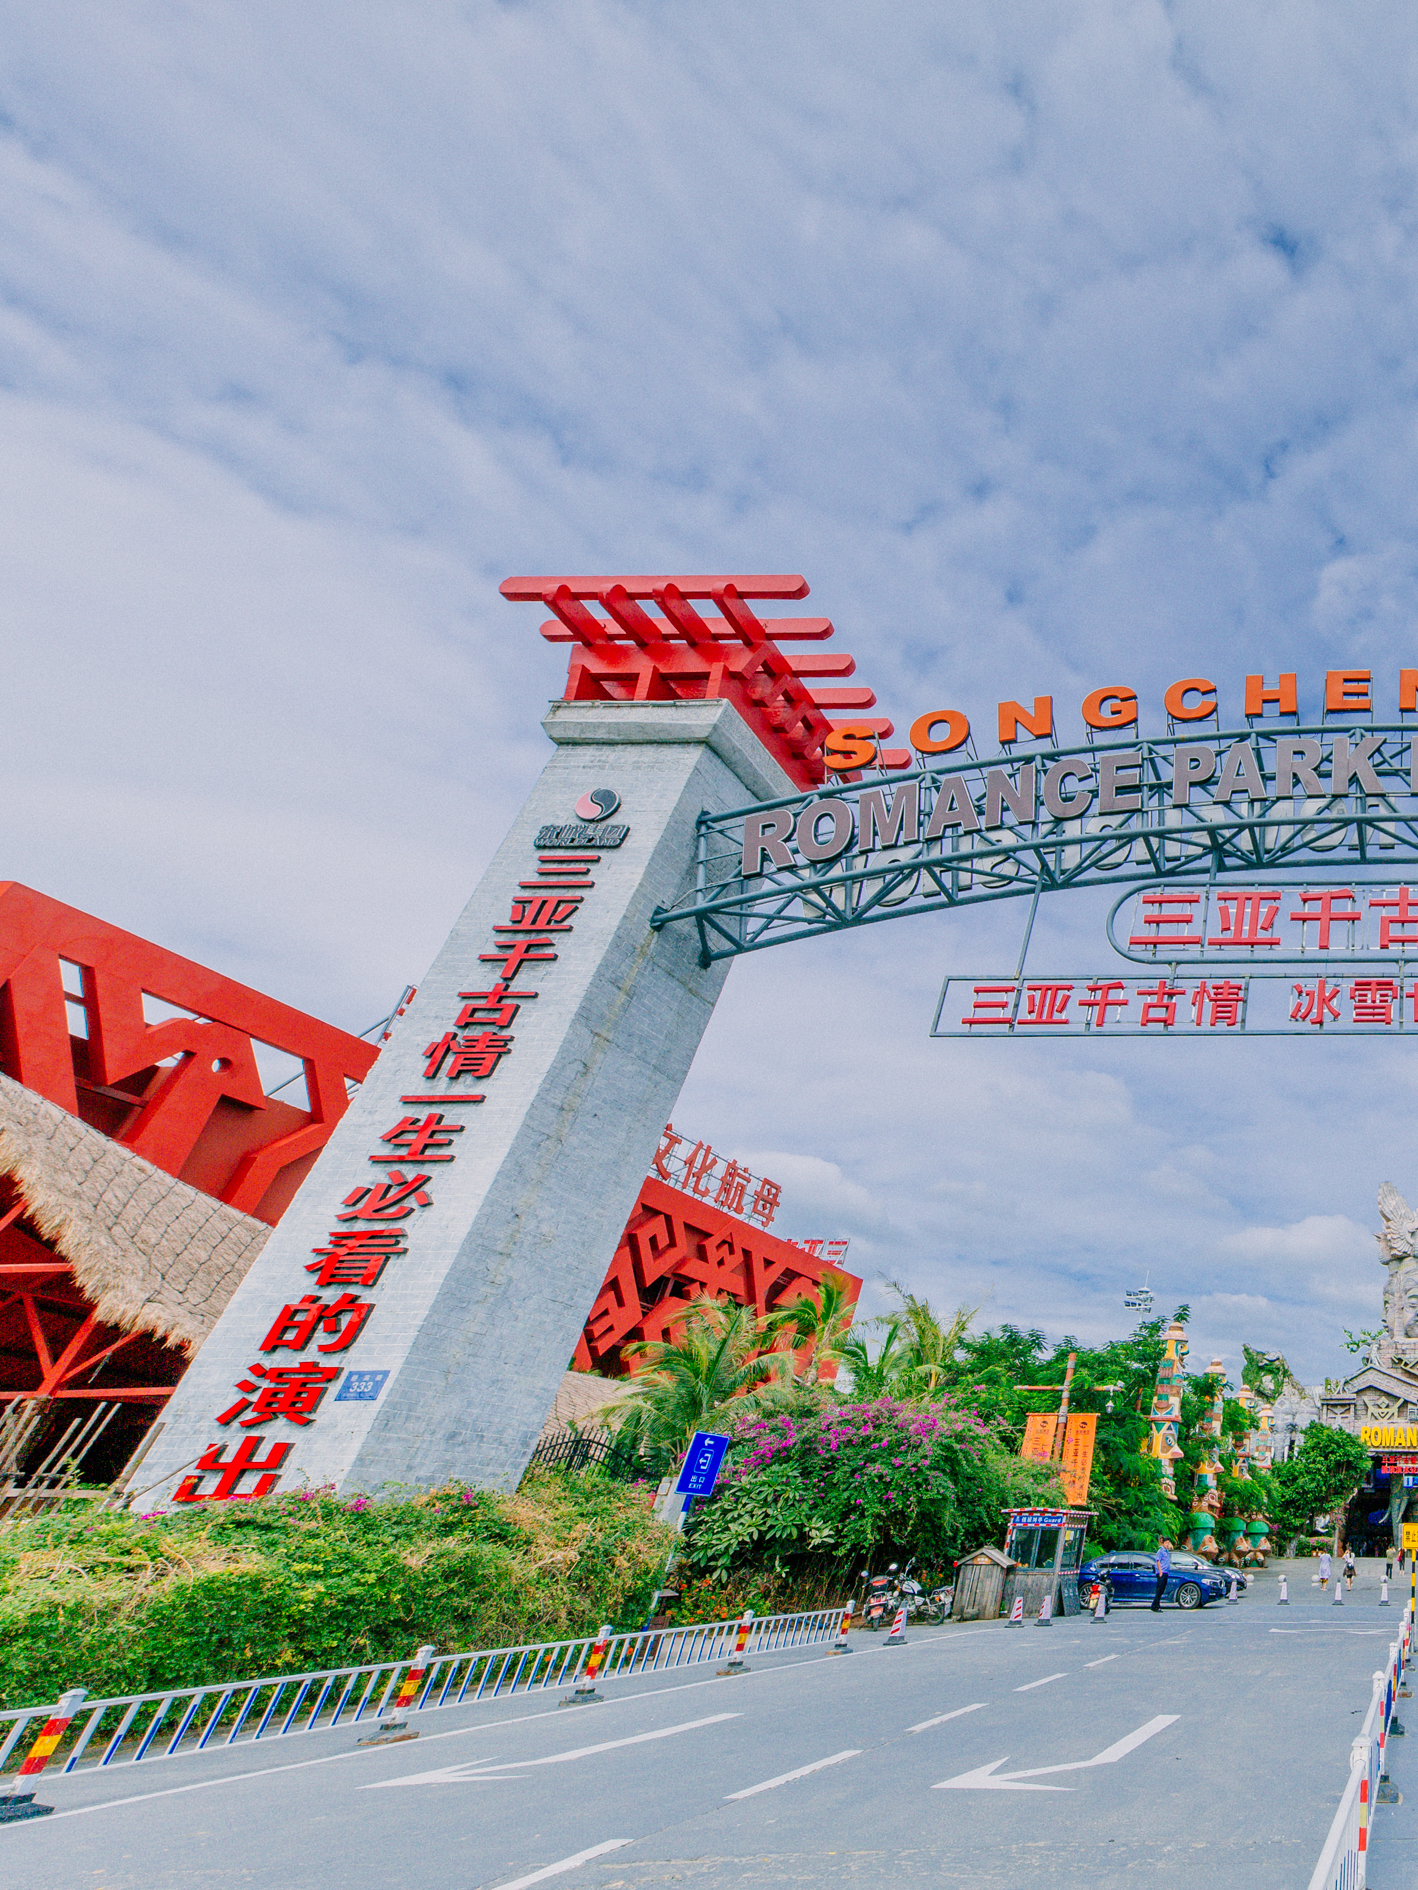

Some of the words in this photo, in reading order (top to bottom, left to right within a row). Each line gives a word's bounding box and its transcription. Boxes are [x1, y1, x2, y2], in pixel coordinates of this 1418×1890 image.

[741, 751, 1145, 878] ROMANCE
[1171, 736, 1387, 806] PARK
[961, 980, 1244, 1028] 三亚千古情
[349, 1381, 374, 1393] 333
[690, 1474, 706, 1484] 出口
[688, 1482, 703, 1490] EXIT
